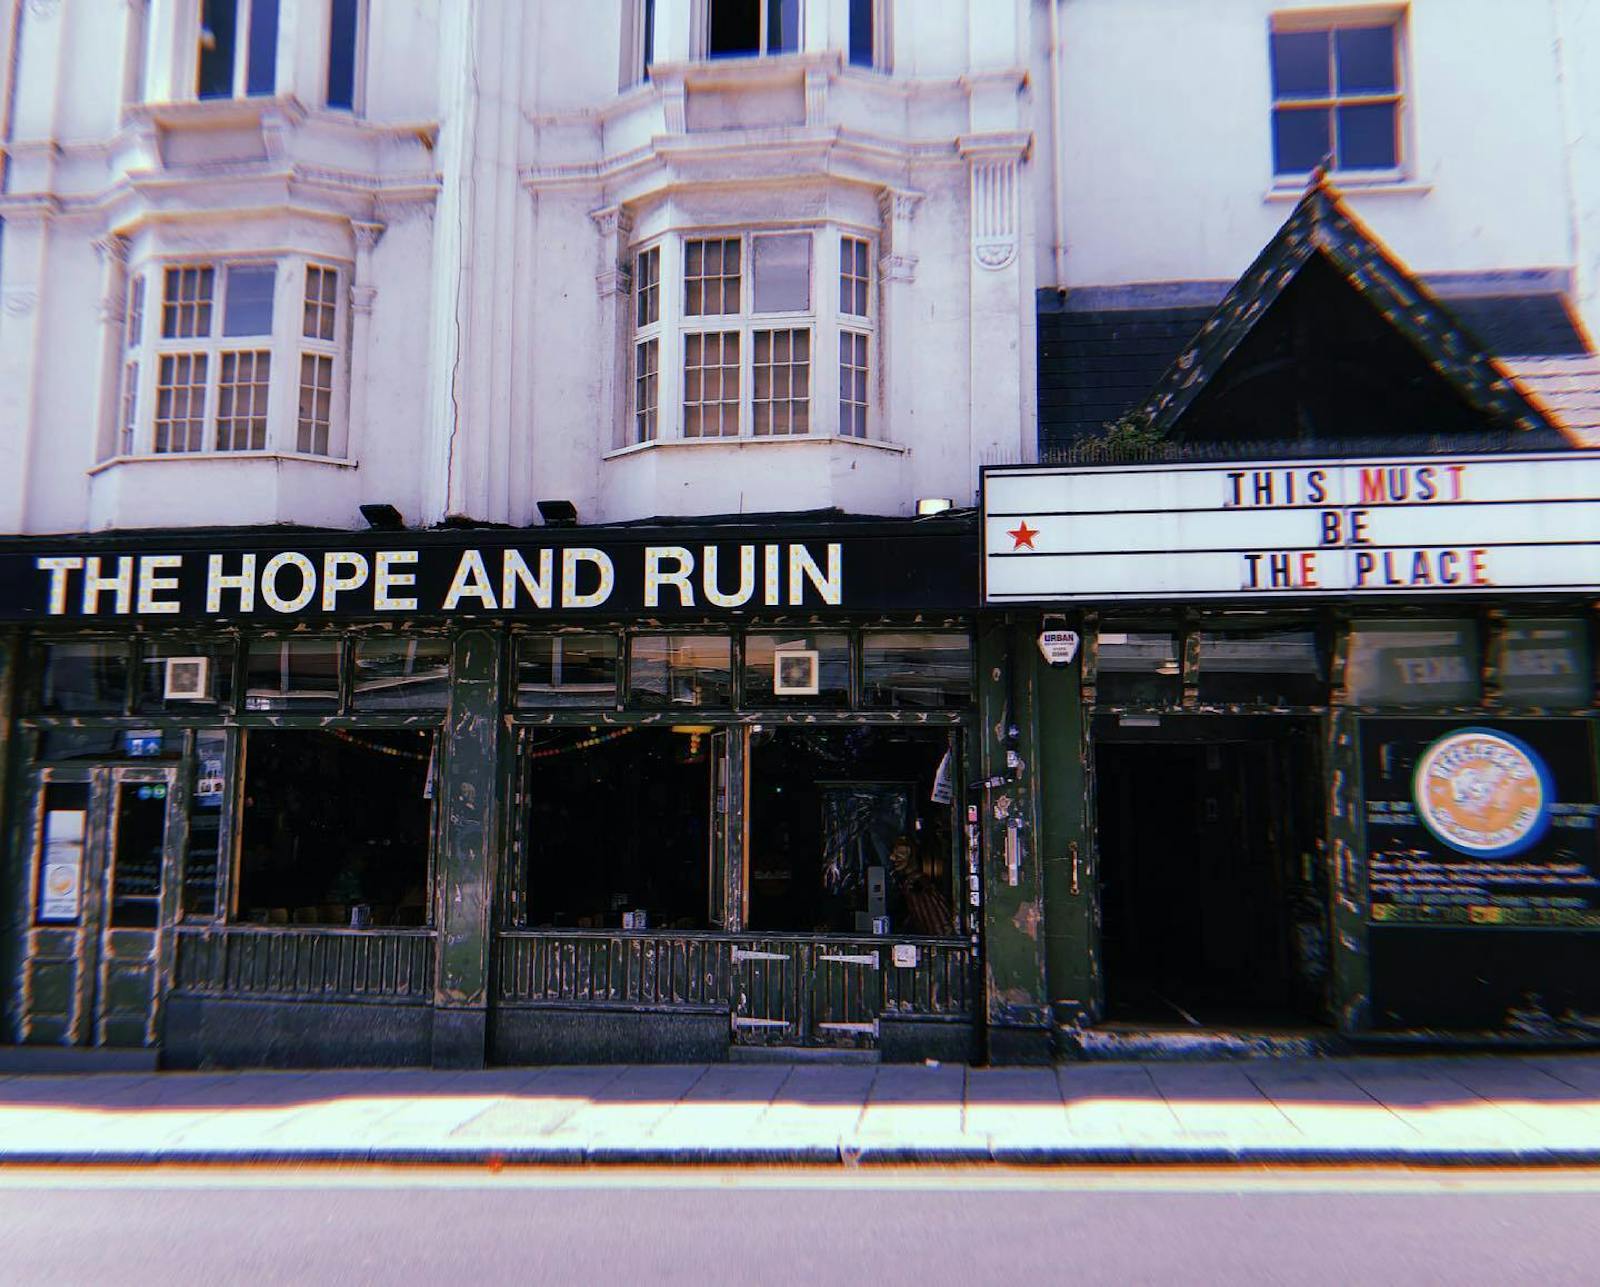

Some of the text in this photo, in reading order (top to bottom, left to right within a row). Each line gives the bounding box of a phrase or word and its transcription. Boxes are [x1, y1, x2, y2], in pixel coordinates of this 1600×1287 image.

[1226, 466, 1466, 506] THIS MUST
[1321, 511, 1370, 545] BE
[38, 544, 841, 615] THE HOPE AND RUIN
[1243, 549, 1490, 589] THE PLACE
[1044, 633, 1074, 642] URBAN
